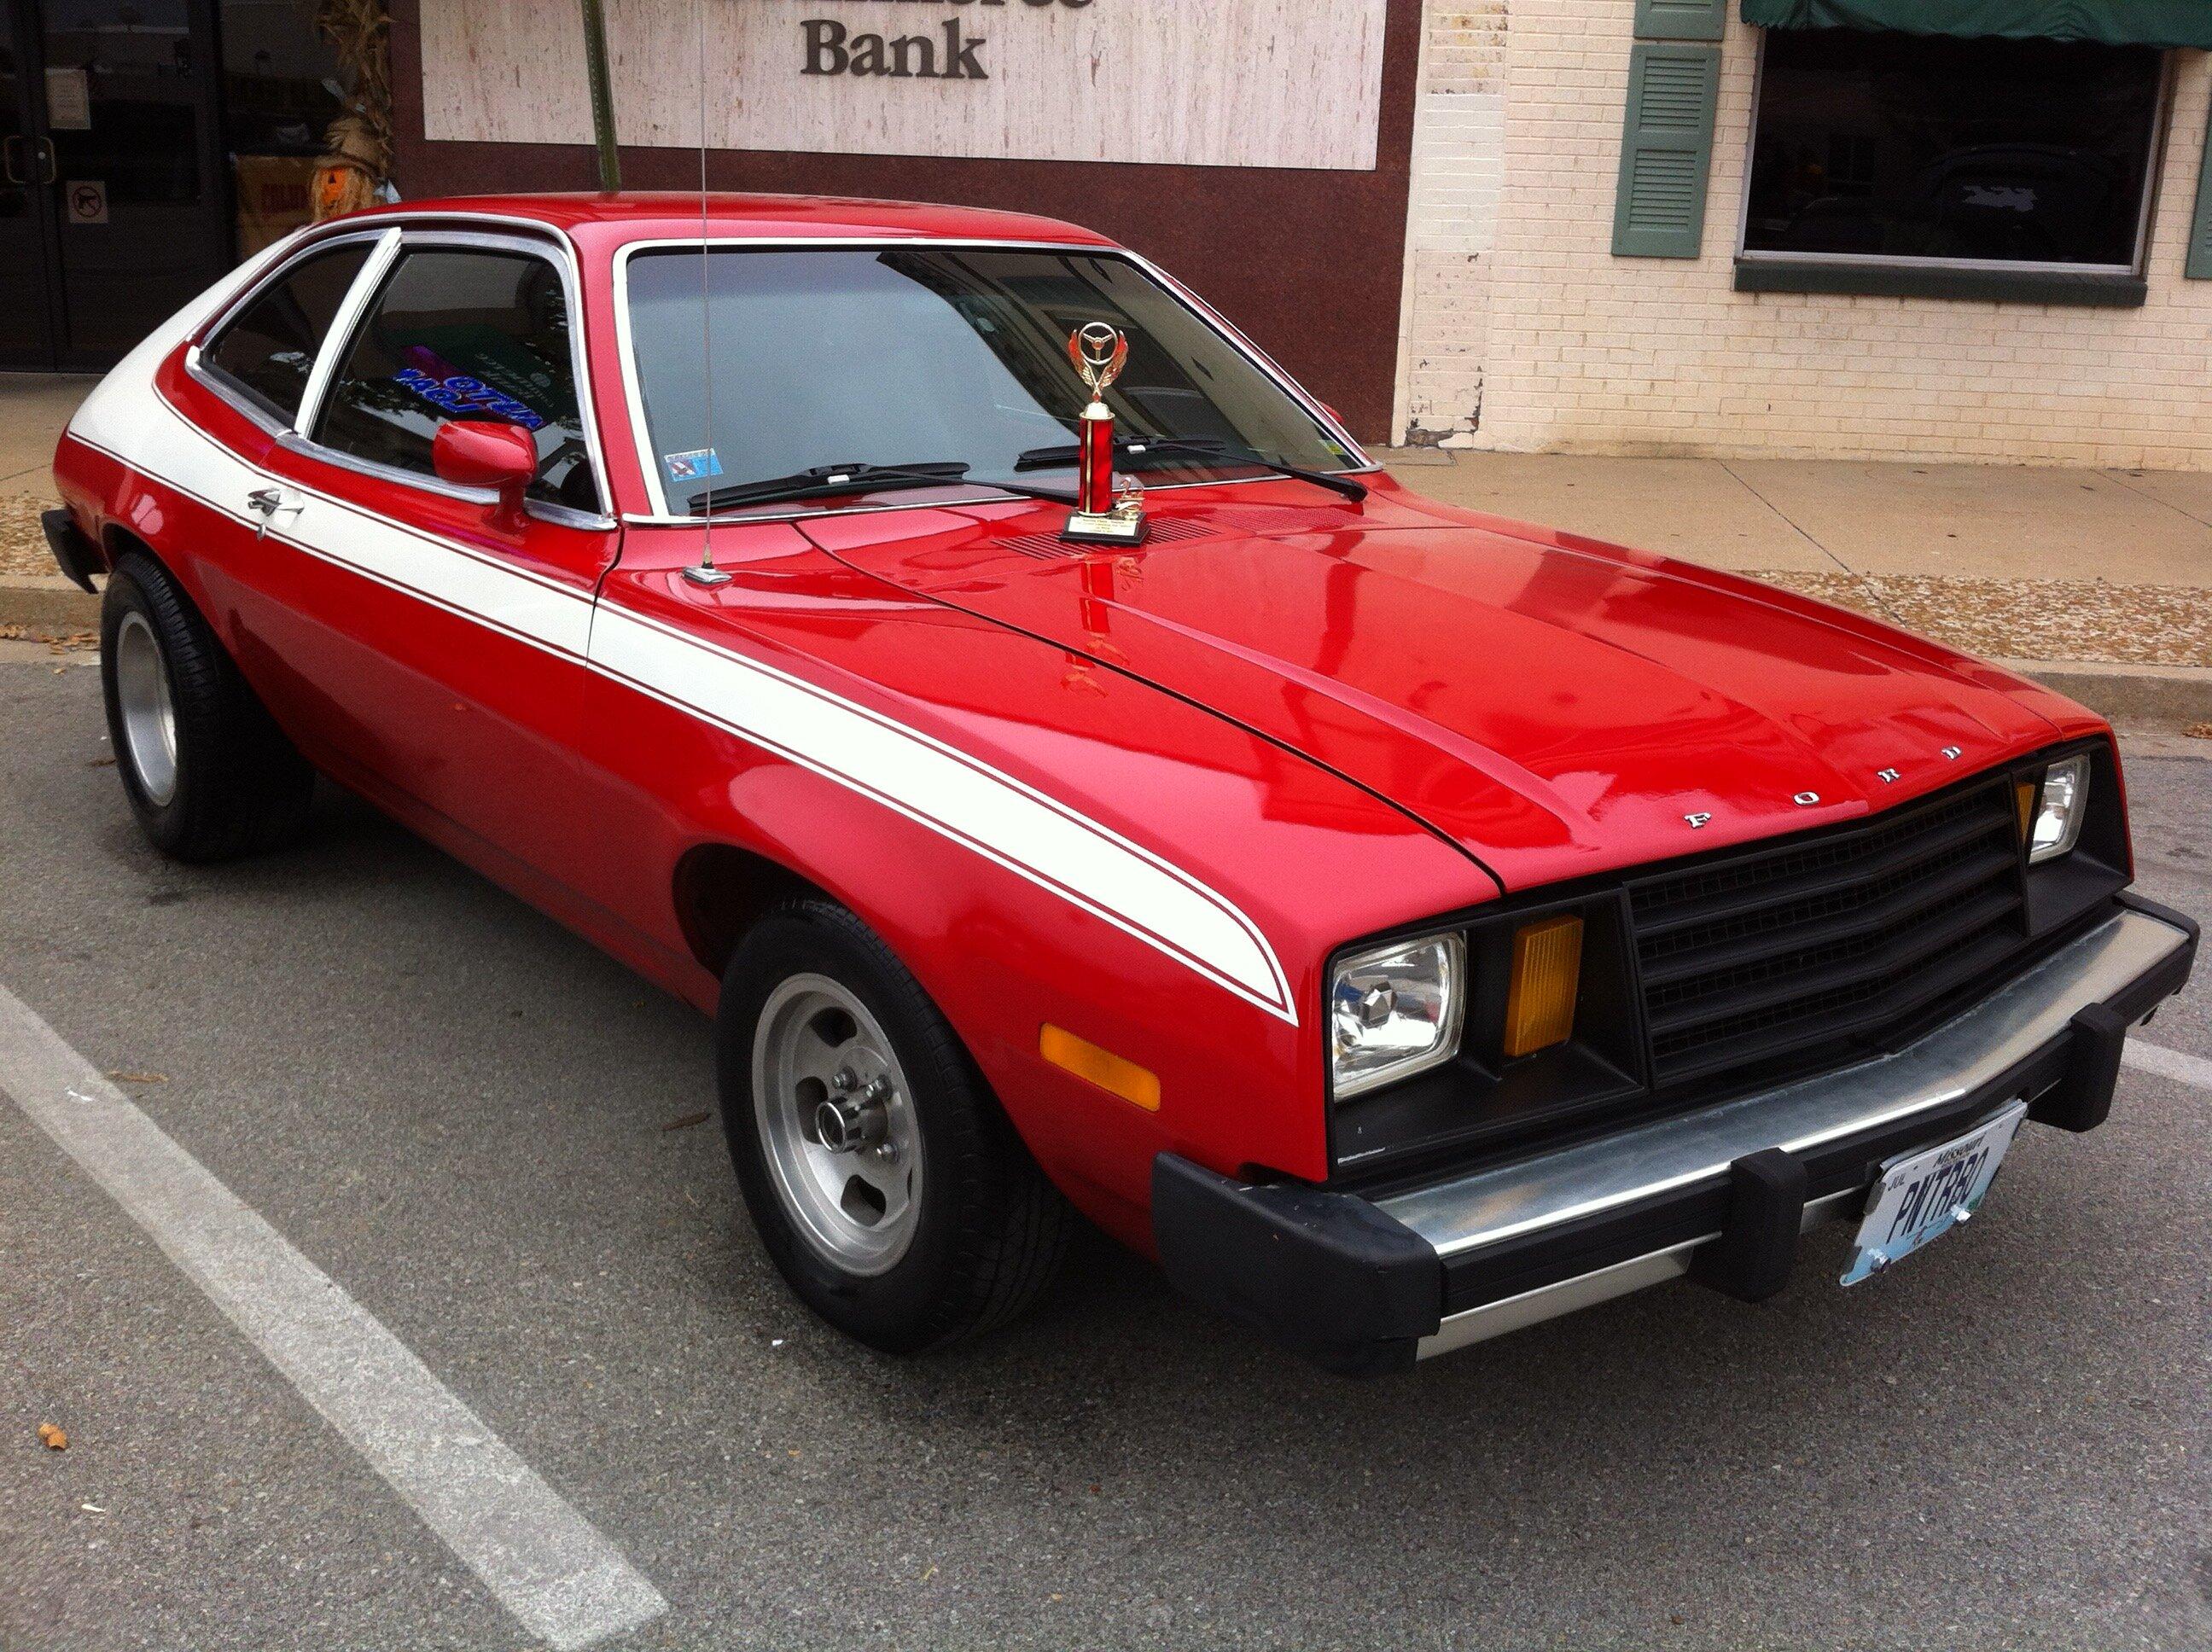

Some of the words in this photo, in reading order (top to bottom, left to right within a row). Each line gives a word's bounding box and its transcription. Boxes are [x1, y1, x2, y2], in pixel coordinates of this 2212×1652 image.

[800, 17, 989, 79] Bank
[1684, 745, 1963, 829] FORD
[1888, 1173, 1905, 1191] JUL
